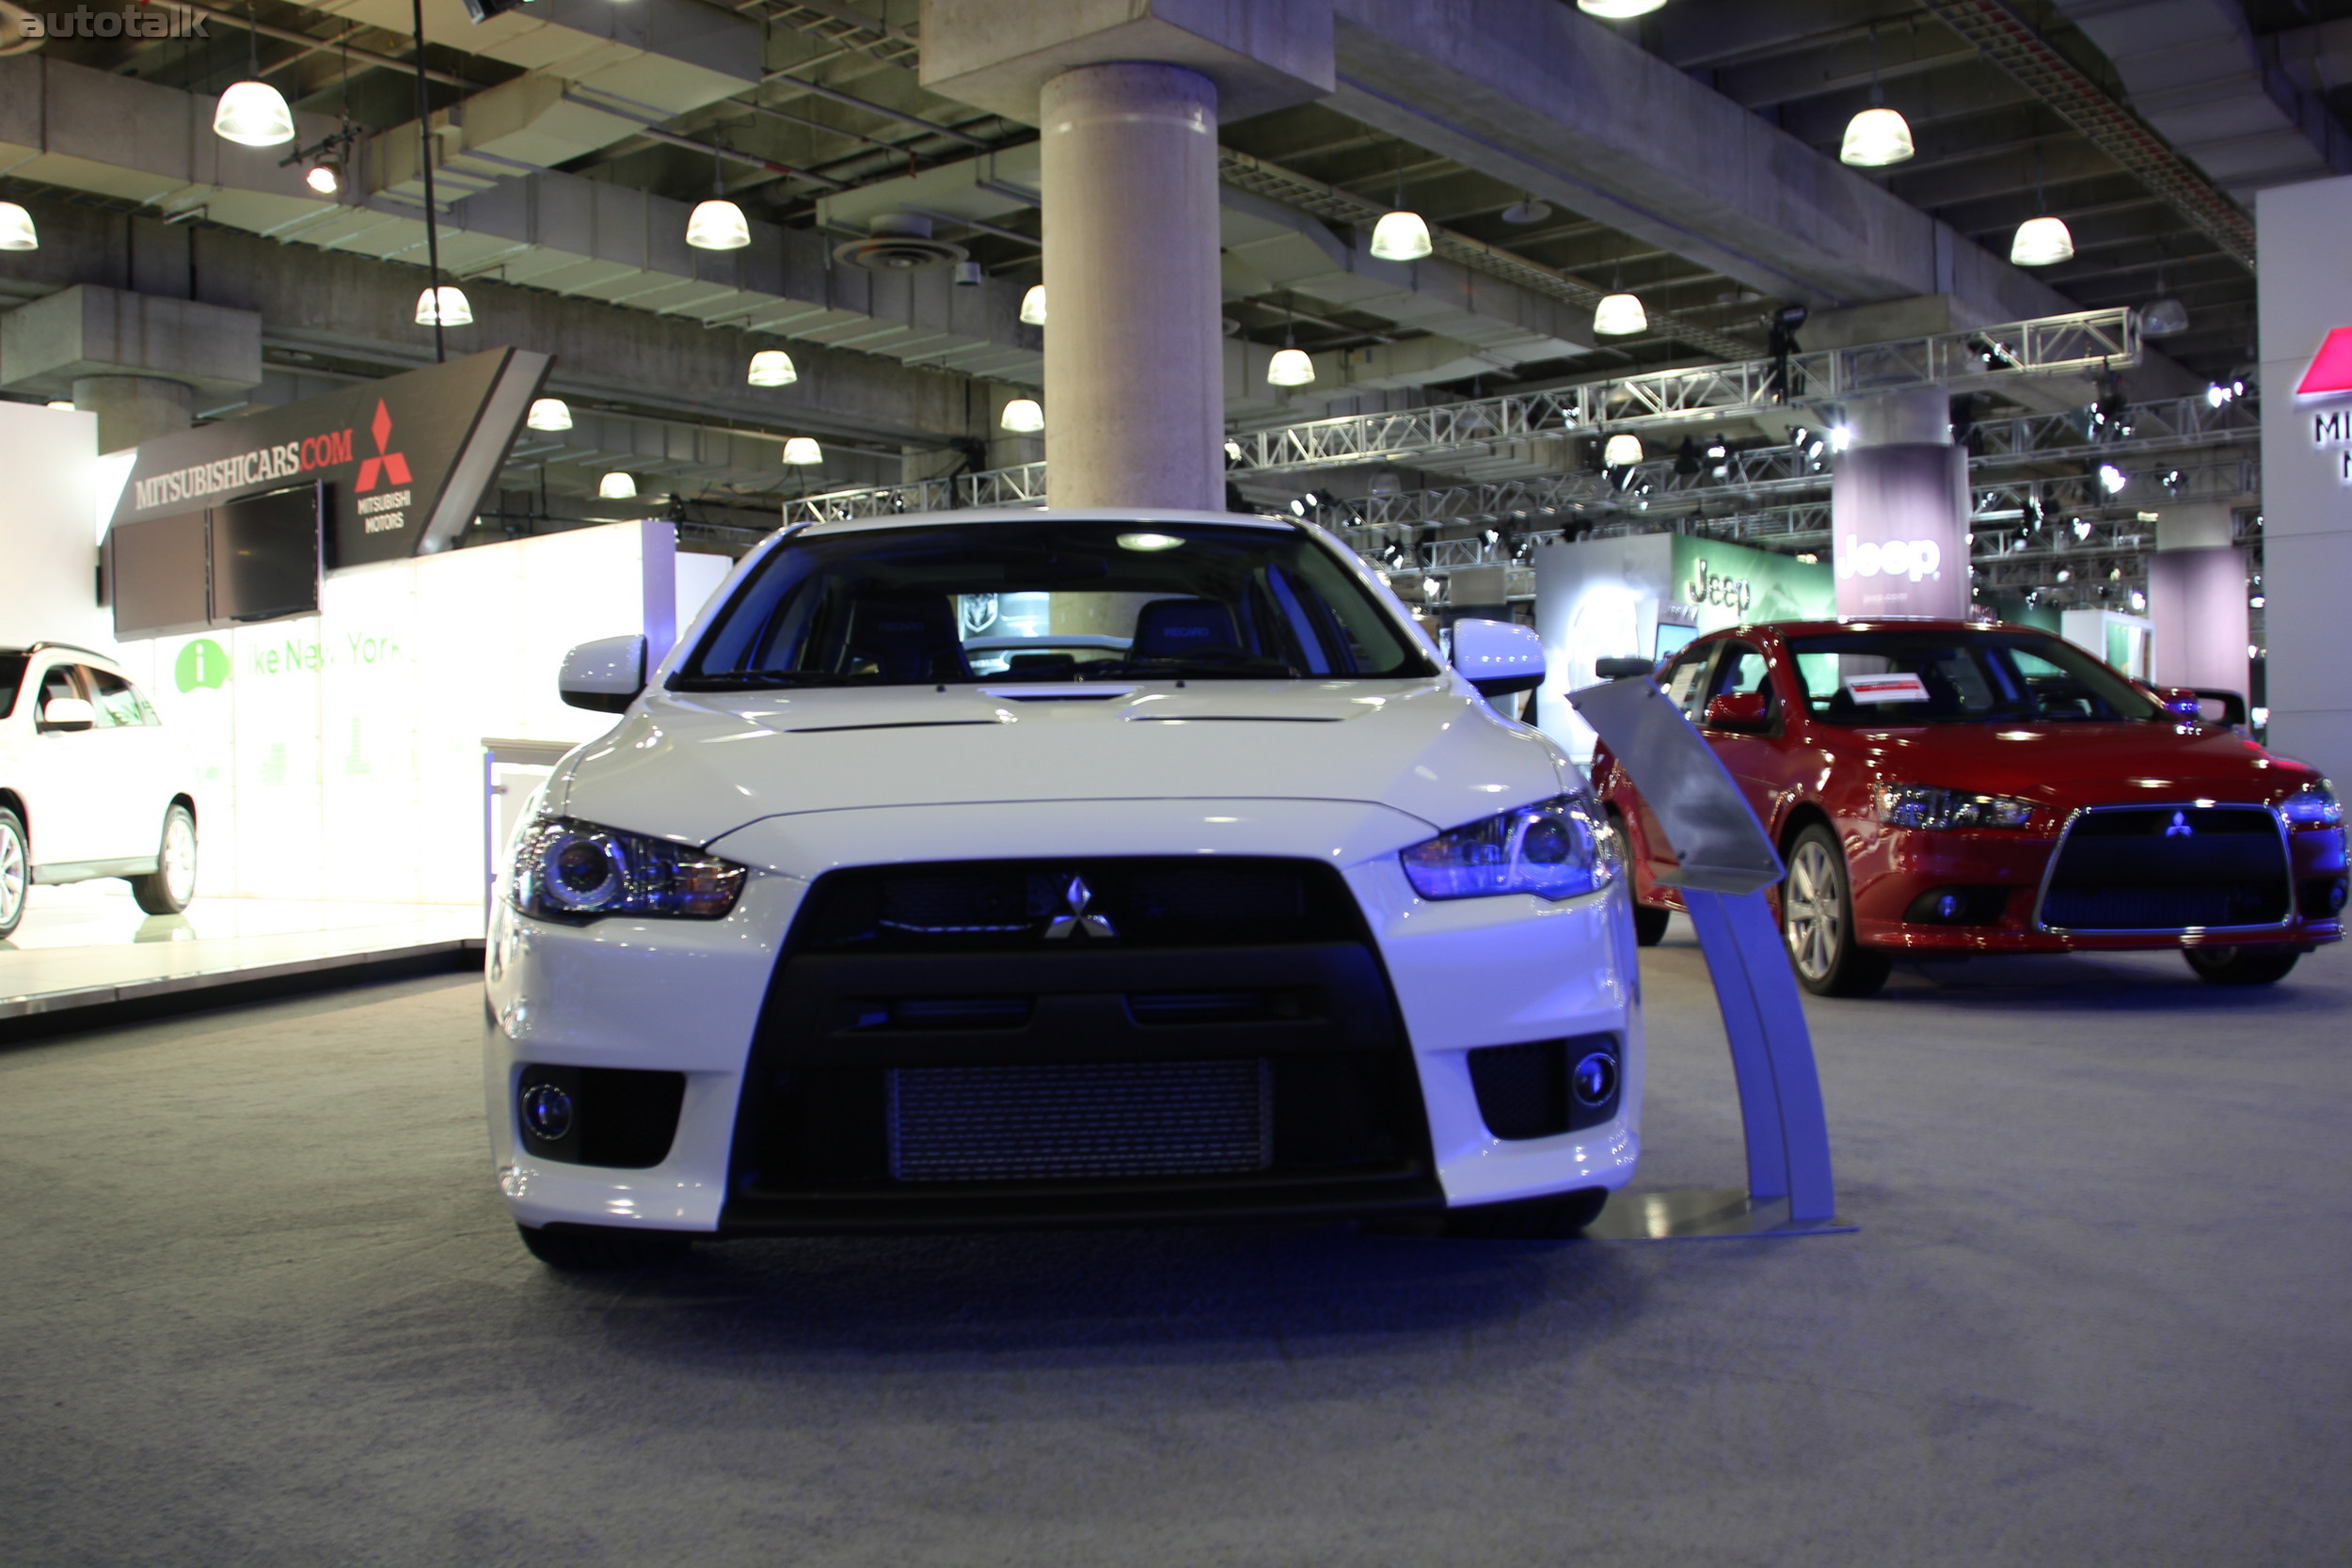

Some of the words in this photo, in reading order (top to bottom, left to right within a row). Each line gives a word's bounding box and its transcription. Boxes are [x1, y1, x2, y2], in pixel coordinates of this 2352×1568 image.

[135, 428, 354, 510] MITSUBISHICARS.COM
[358, 490, 412, 515] MITSUBISHI
[365, 512, 405, 533] MOTORS
[1836, 533, 1941, 582] Jeep
[1687, 558, 1751, 619] Jeep
[285, 638, 335, 672] Ne
